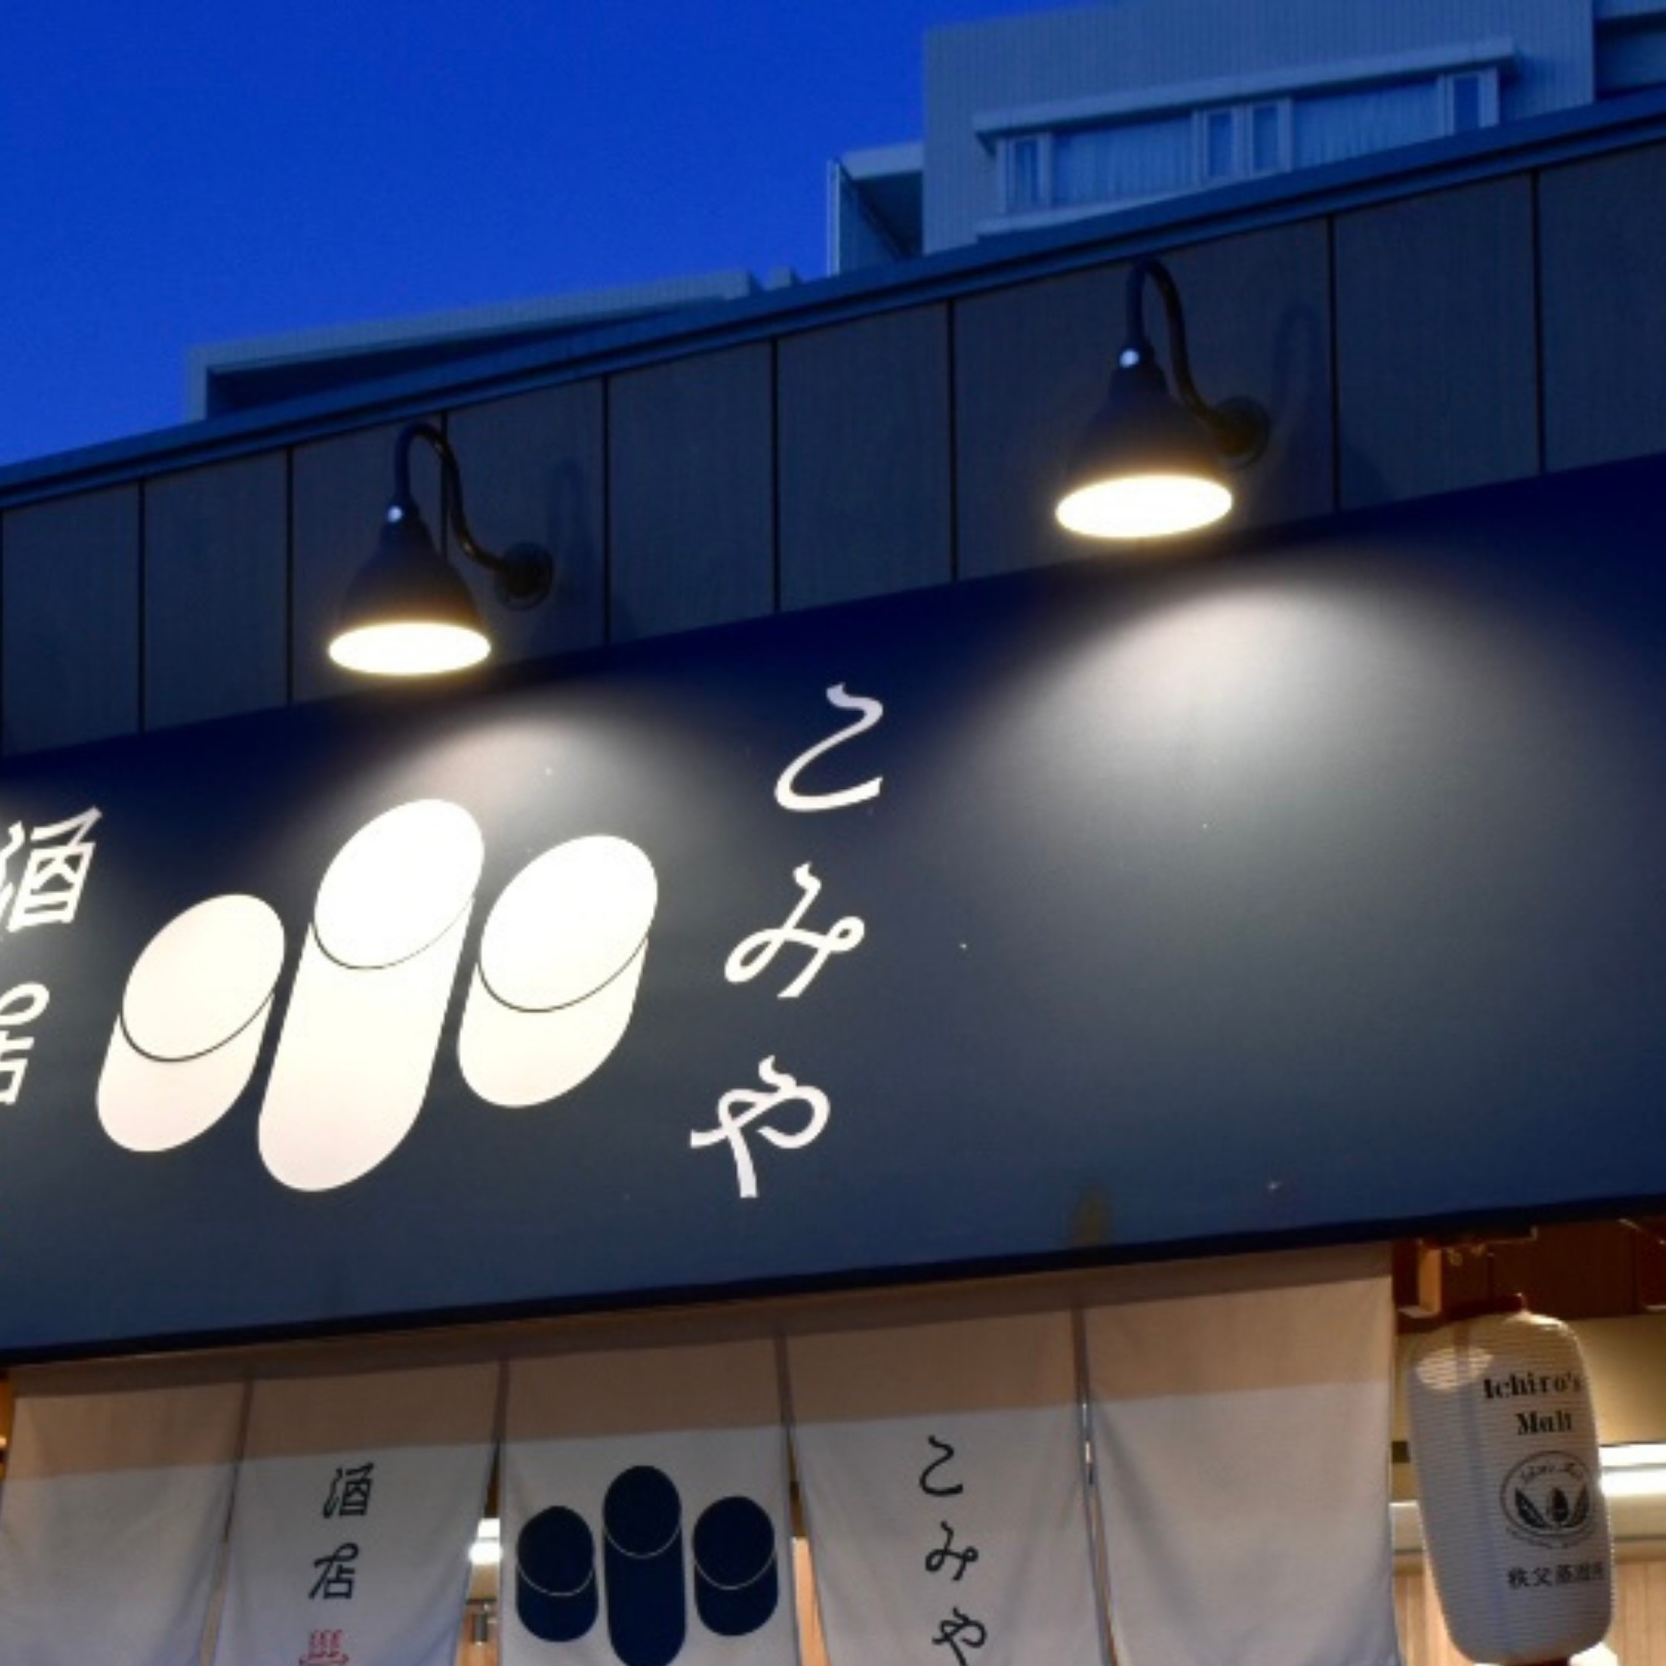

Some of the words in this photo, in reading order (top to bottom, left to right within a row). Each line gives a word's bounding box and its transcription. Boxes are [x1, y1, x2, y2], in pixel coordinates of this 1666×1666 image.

[1484, 1371, 1584, 1399] Ichiro's
[1517, 1411, 1573, 1436] Malt
[307, 1462, 375, 1601] 酒店
